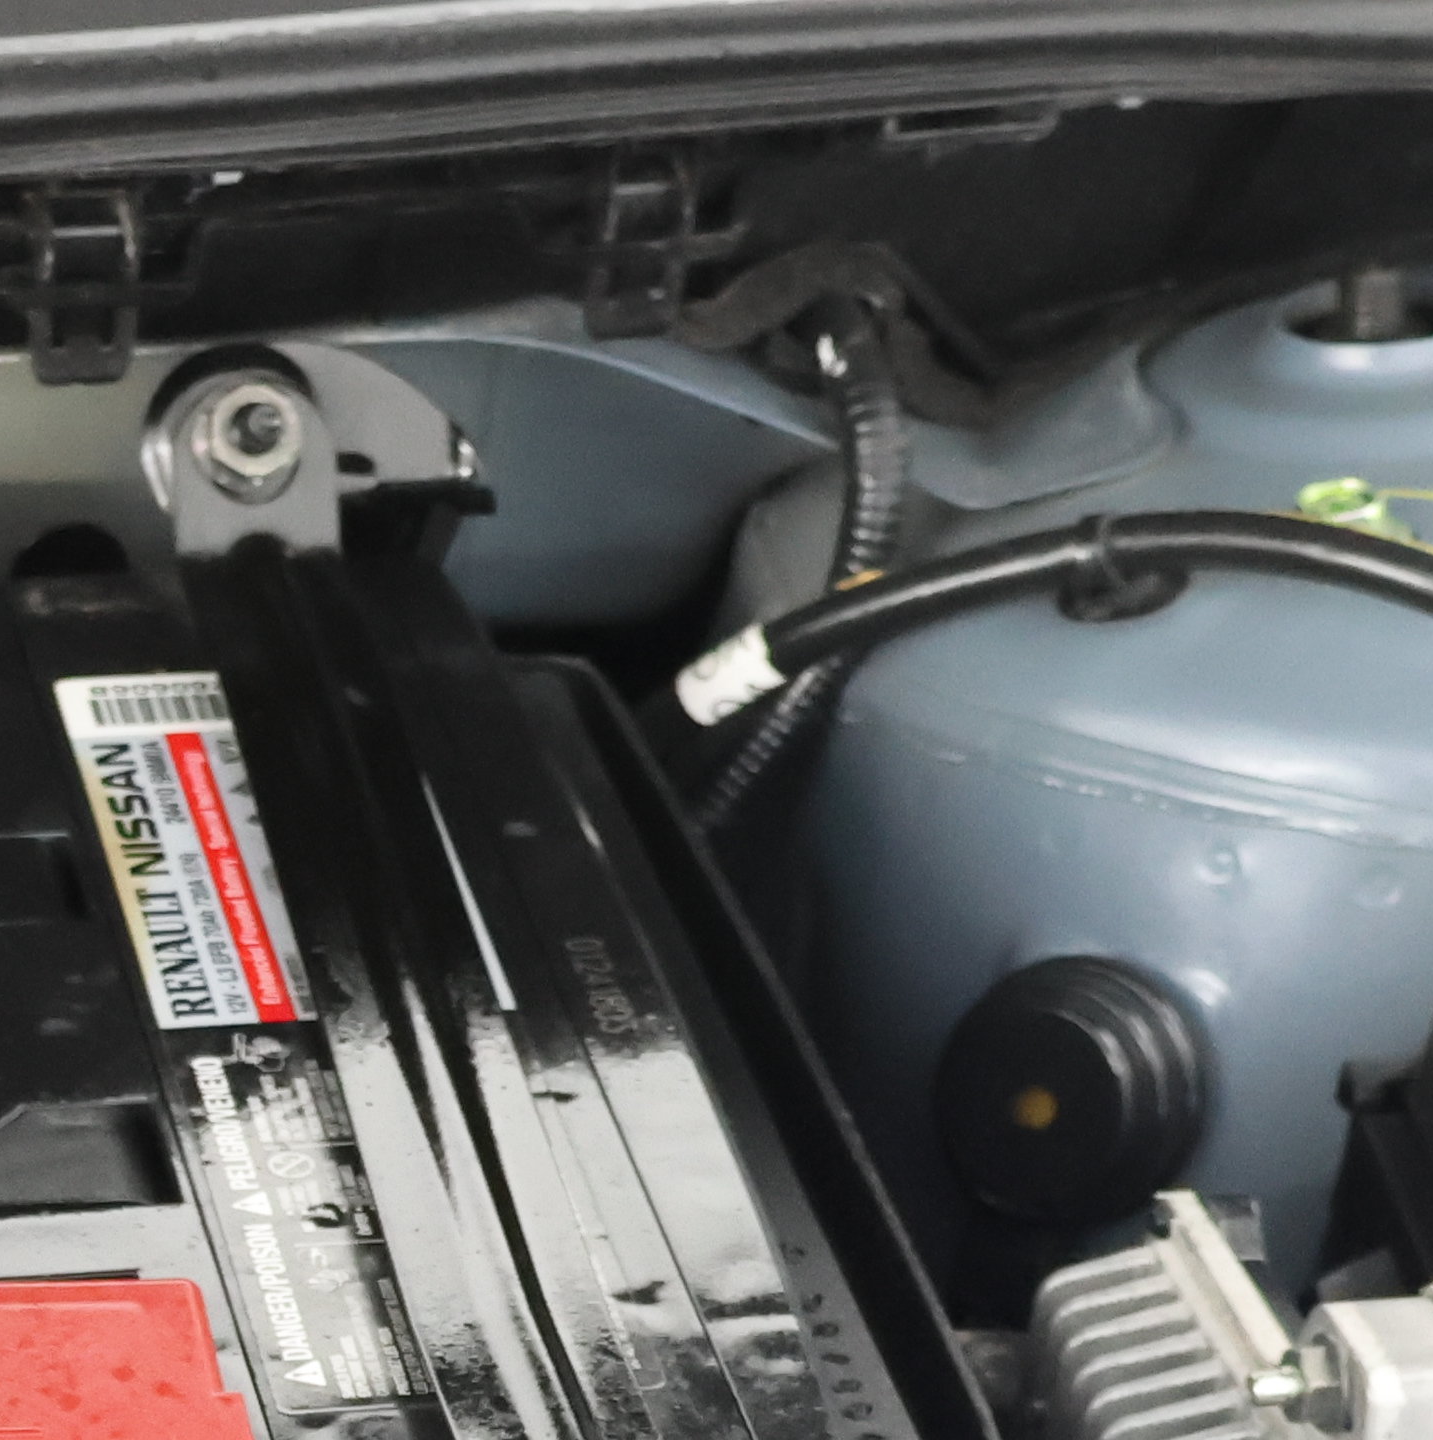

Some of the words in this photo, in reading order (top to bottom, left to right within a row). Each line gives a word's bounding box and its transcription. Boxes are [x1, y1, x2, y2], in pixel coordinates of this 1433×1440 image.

[90, 743, 171, 877] NISSAN
[135, 888, 218, 1018] RENAULT
[223, 994, 249, 1015] 12V
[190, 1056, 259, 1191] PELIGRO/VENENO
[242, 1223, 314, 1361] DANGER/POISON
